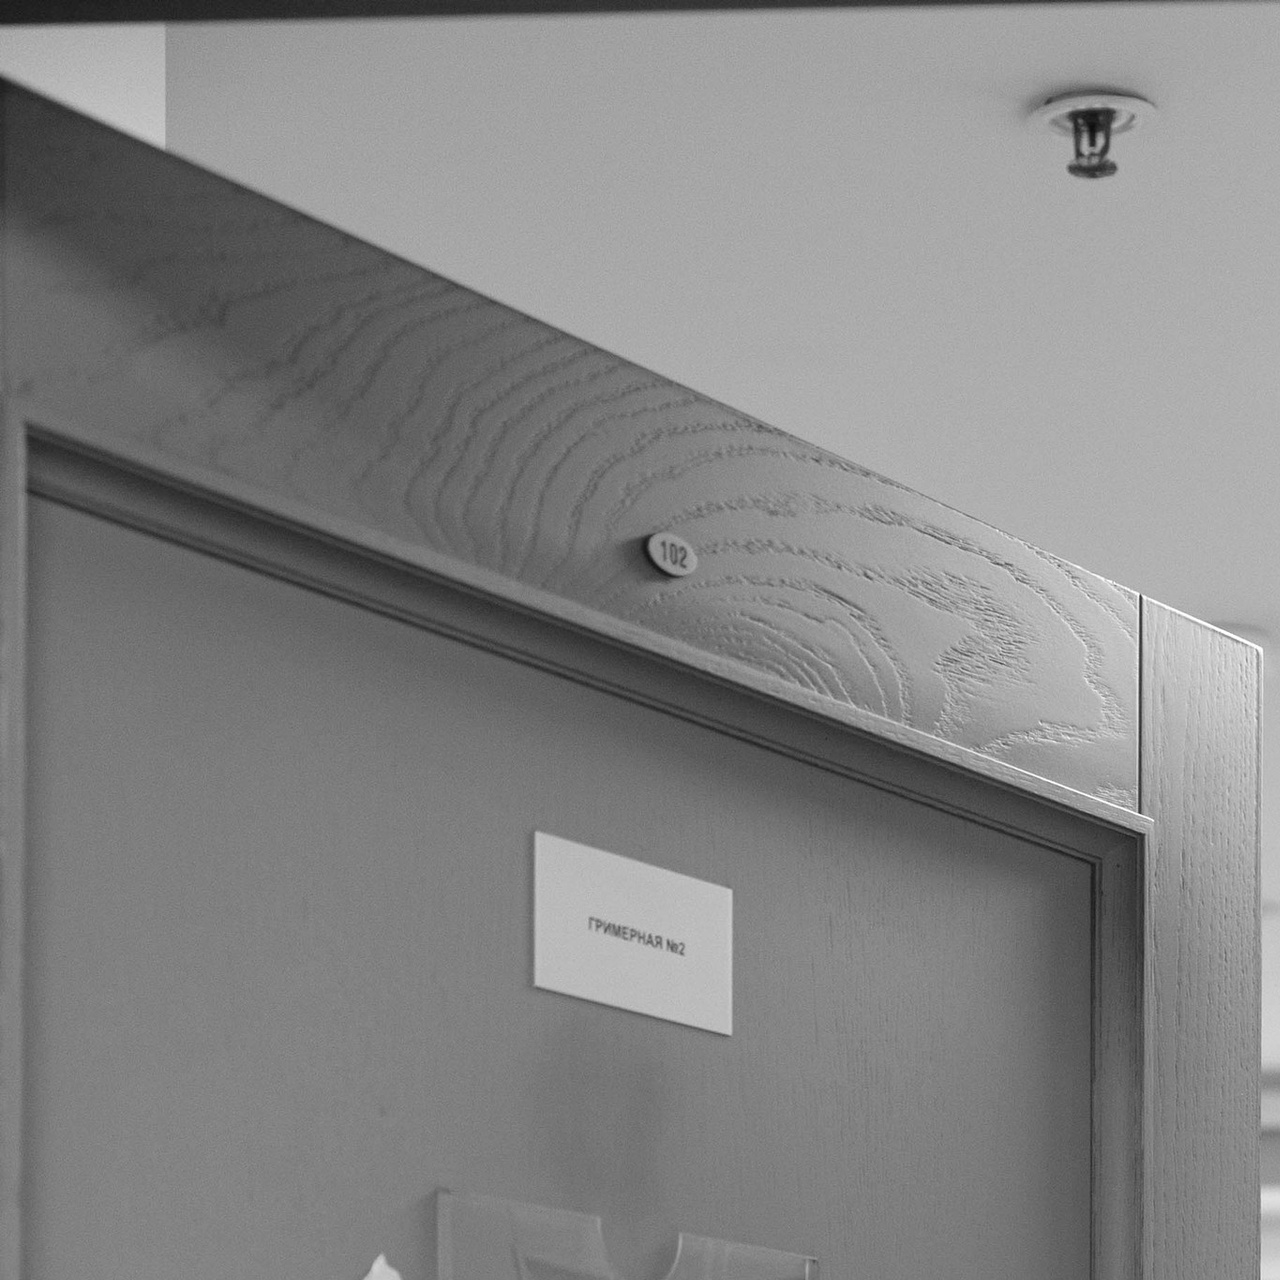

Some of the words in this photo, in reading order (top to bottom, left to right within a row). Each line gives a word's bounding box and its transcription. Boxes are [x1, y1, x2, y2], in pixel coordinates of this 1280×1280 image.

[661, 540, 687, 568] 102
[588, 917, 663, 949] ГРИМЕРНАЯ
[666, 939, 686, 956] №2
